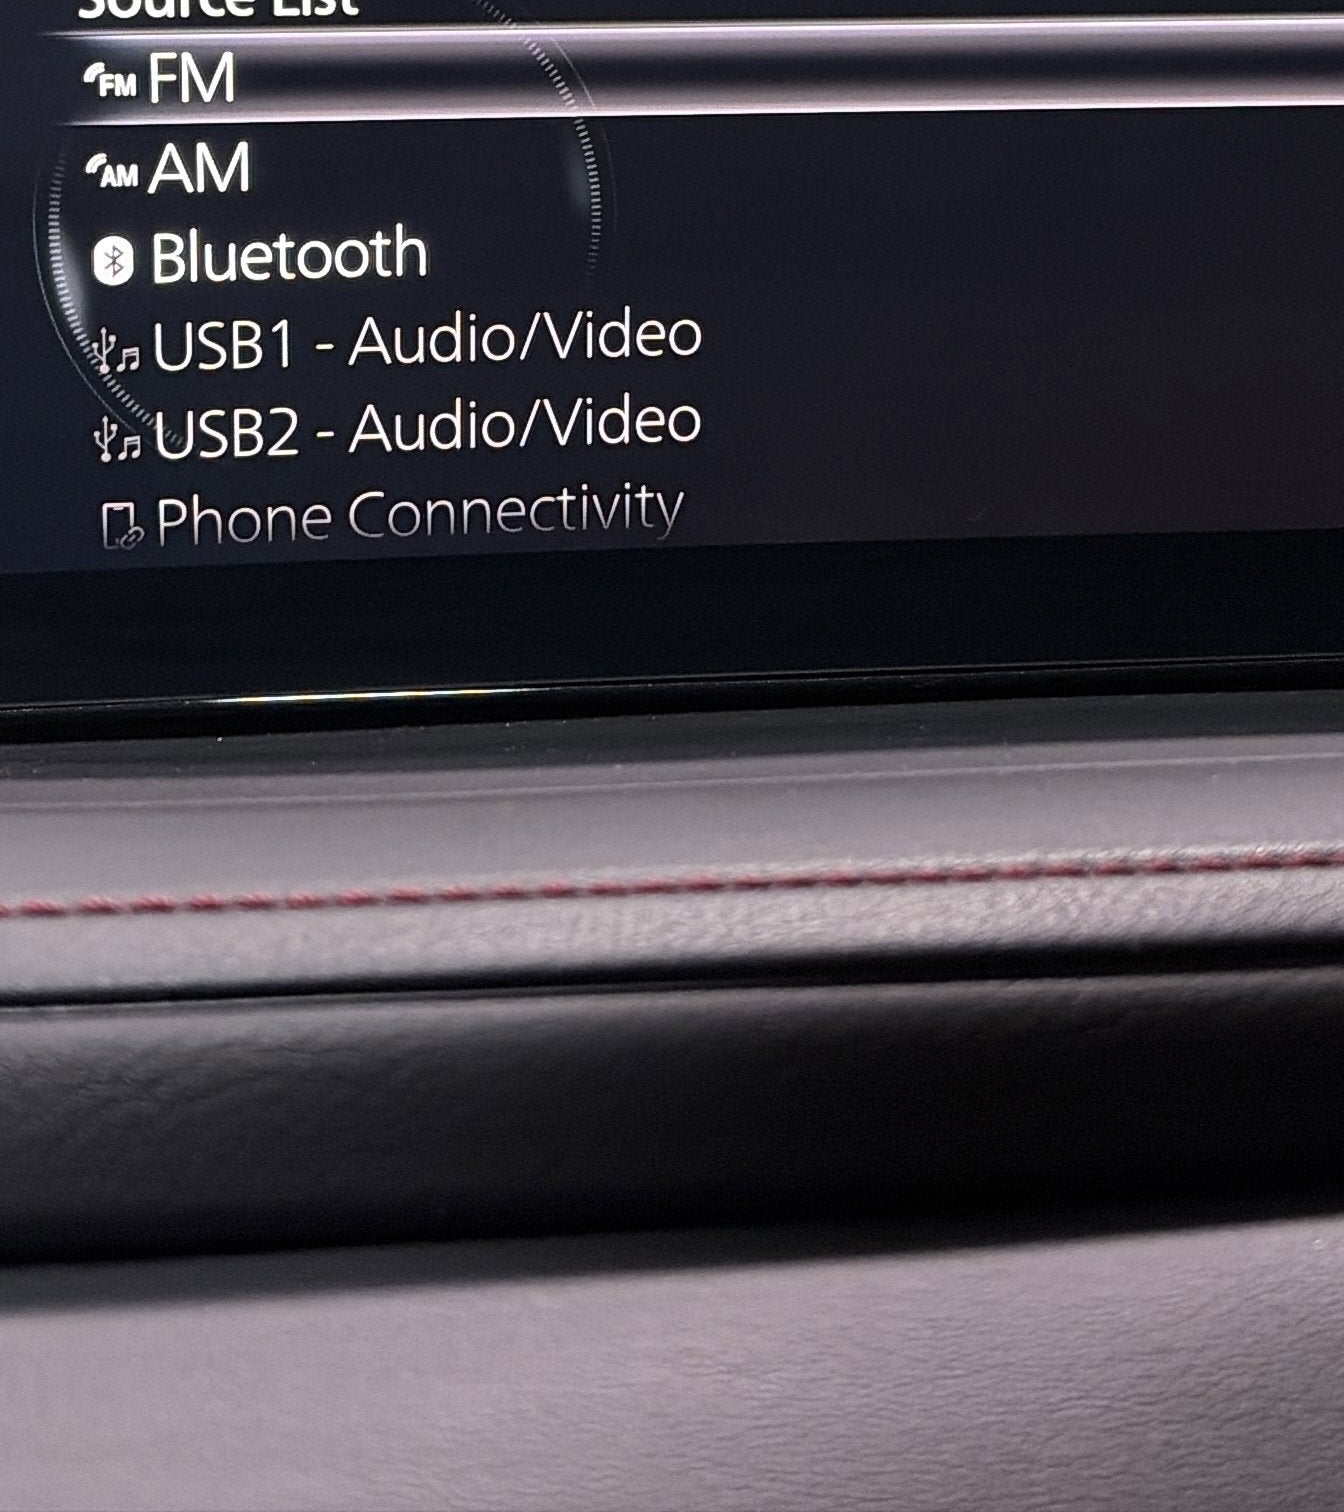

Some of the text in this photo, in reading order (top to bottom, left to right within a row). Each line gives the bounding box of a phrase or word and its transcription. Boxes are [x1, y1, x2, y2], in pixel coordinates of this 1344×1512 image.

[98, 50, 235, 104] FM FM
[99, 140, 250, 195] AM AM
[152, 222, 427, 285] Bluetooth
[153, 318, 290, 372] USB1
[347, 305, 702, 366] Audio/Video
[154, 405, 300, 460] USB2
[347, 391, 702, 454] Audio/Video
[158, 481, 686, 547] Phone Connectivity
